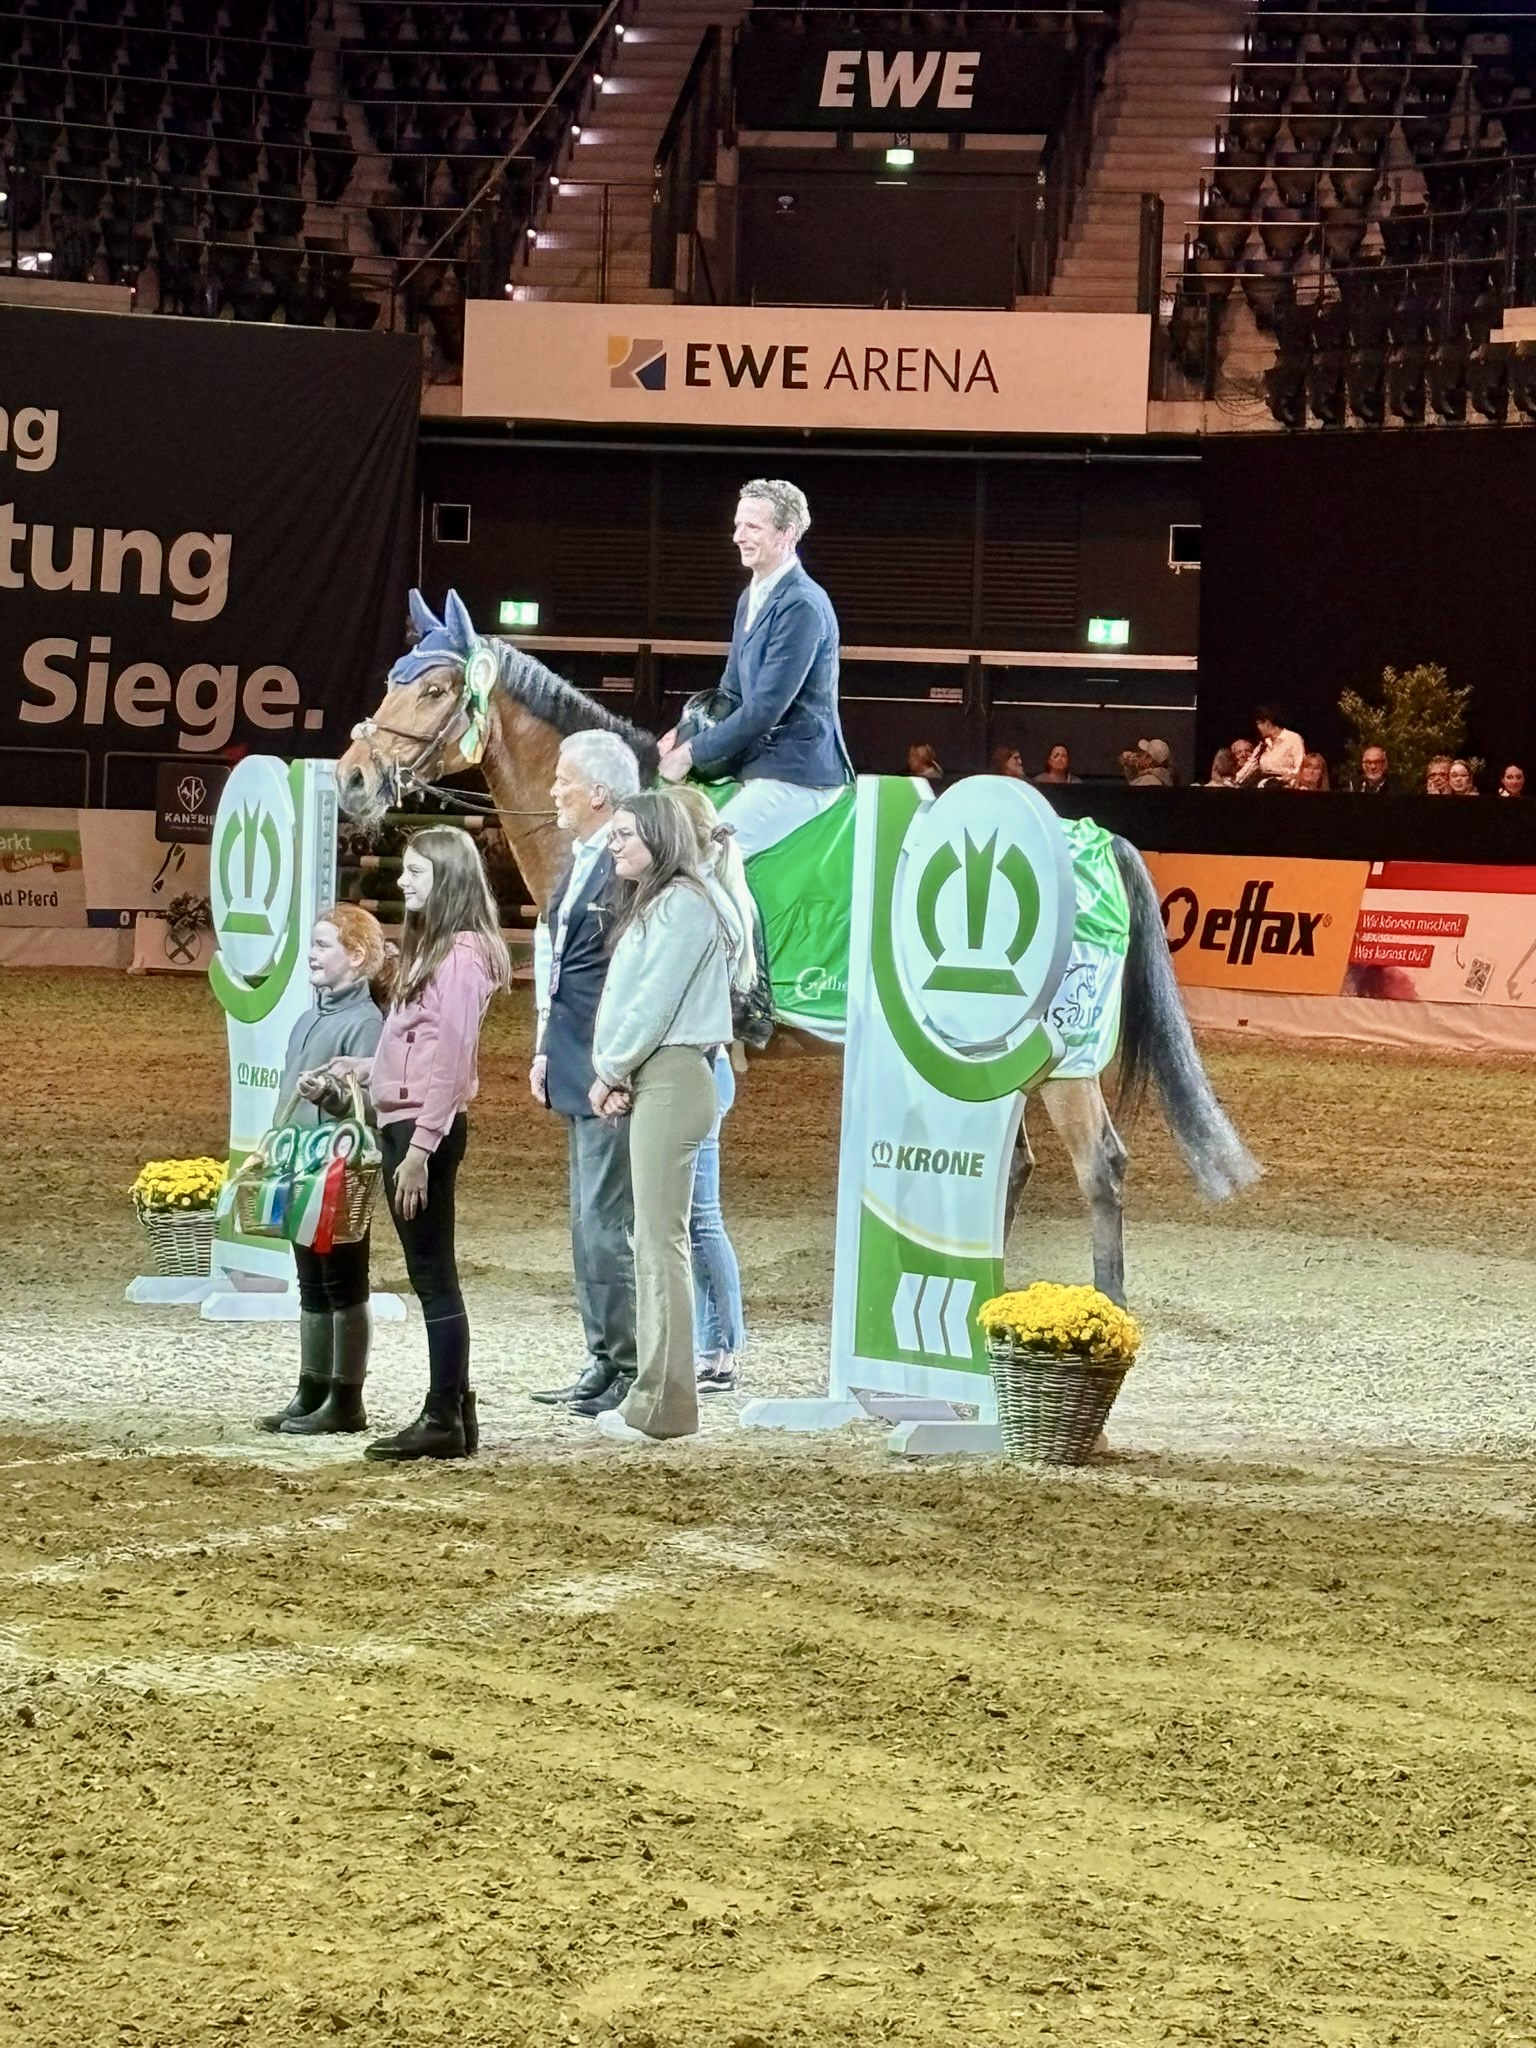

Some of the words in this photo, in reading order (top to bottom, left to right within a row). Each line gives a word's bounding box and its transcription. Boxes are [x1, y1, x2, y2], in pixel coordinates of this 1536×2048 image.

[819, 50, 981, 109] EWE
[685, 343, 809, 389] EWE
[824, 346, 999, 393] ARENA
[0, 406, 59, 472] g
[19, 636, 324, 752] Siege.
[18, 889, 58, 907] Pferd
[1363, 914, 1379, 928] Wir
[1379, 914, 1416, 930] können
[1416, 917, 1462, 932] mischen!
[1354, 945, 1373, 959] Was
[1374, 945, 1407, 961] kannst
[1408, 948, 1428, 961] du?
[896, 1145, 985, 1178] KRONE
